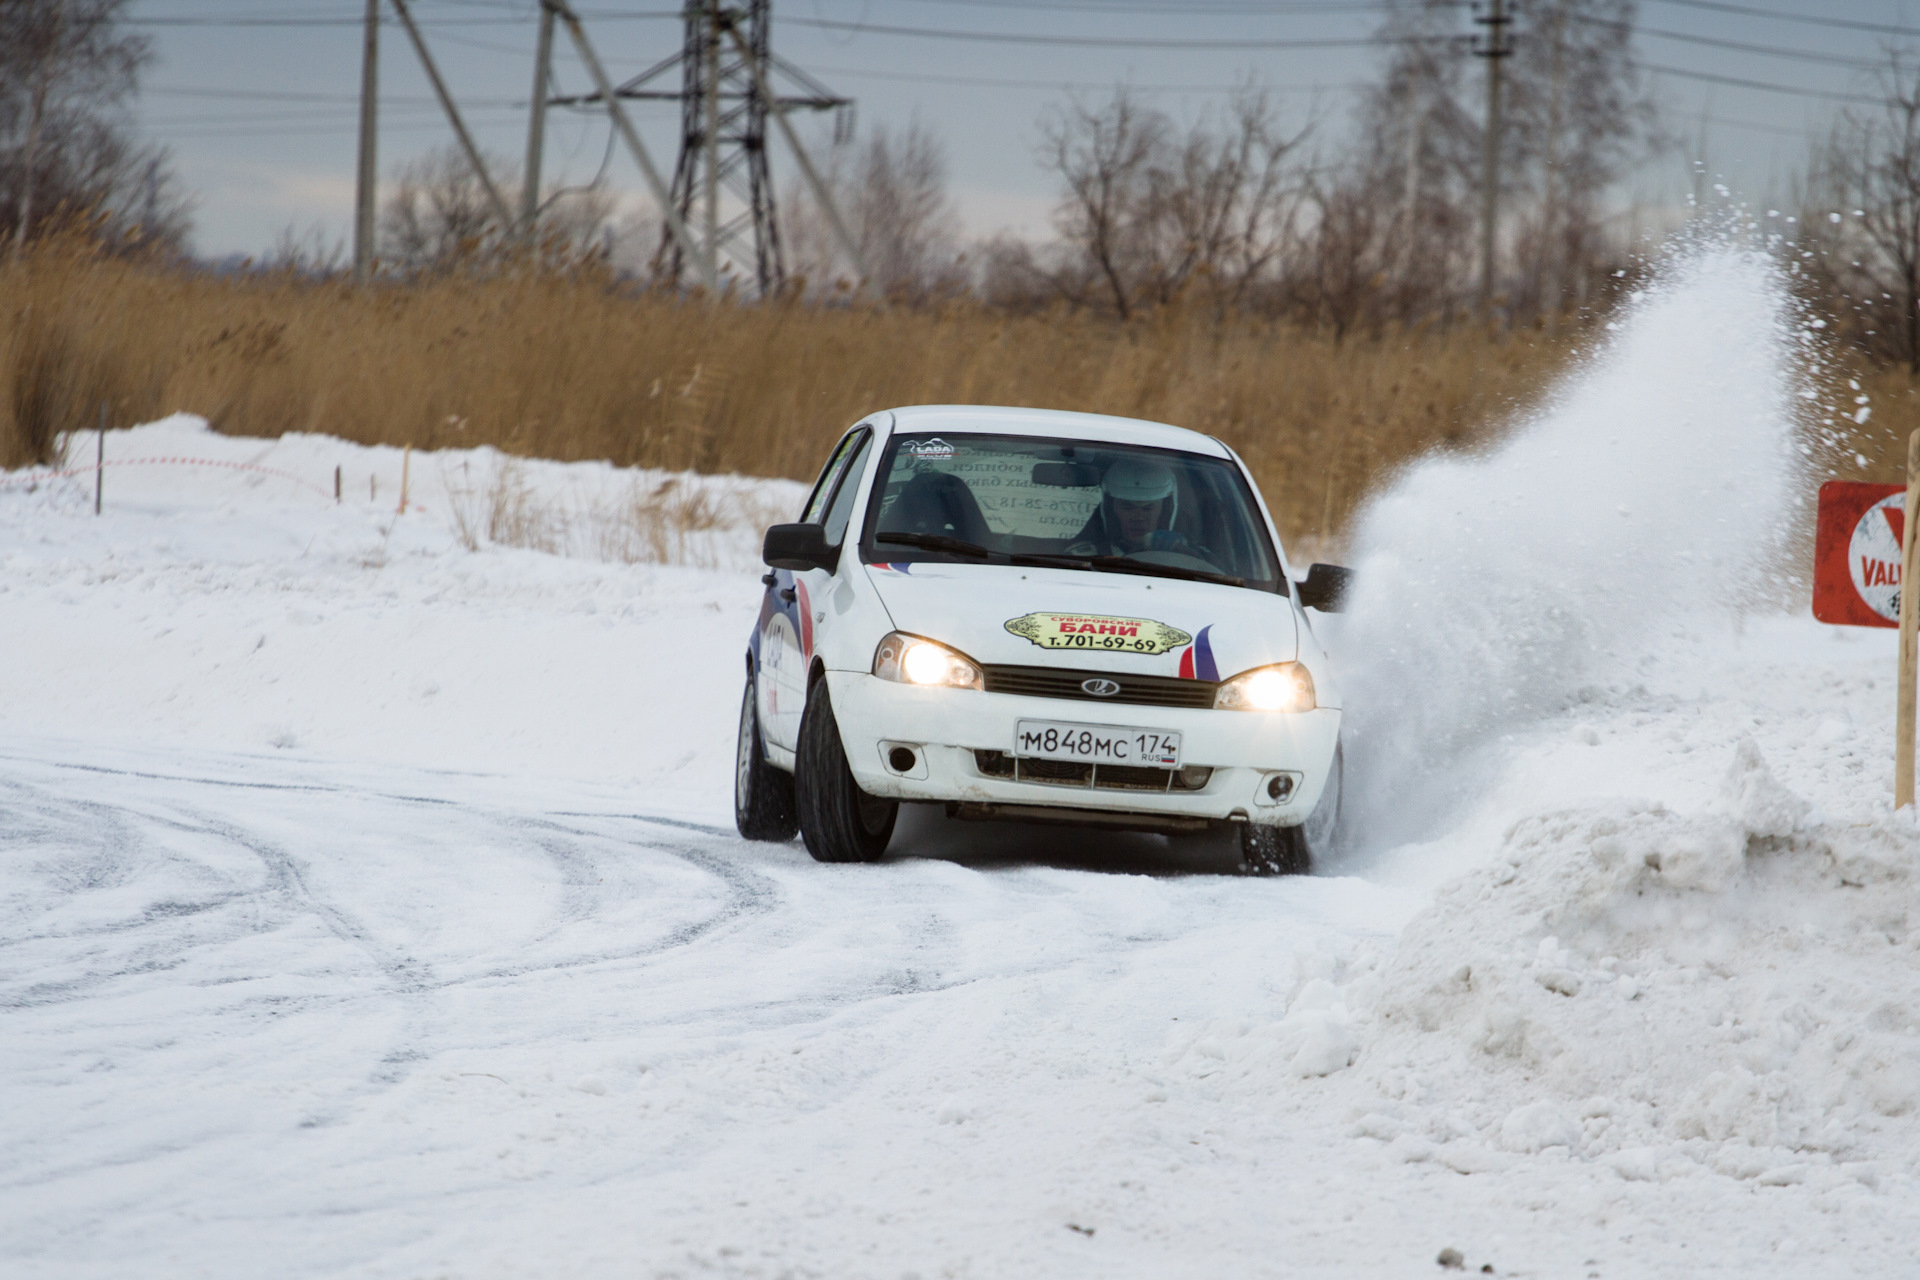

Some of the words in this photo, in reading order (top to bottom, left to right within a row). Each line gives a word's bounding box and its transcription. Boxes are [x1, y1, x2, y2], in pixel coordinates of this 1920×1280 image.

[1861, 555, 1902, 588] VAL
[1051, 616, 1142, 627] СУВОРОВСКИЕ
[1059, 622, 1138, 637] БАНИ
[1024, 728, 1128, 758] М848МС
[1135, 734, 1173, 754] 174
[1141, 753, 1161, 762] RUS
